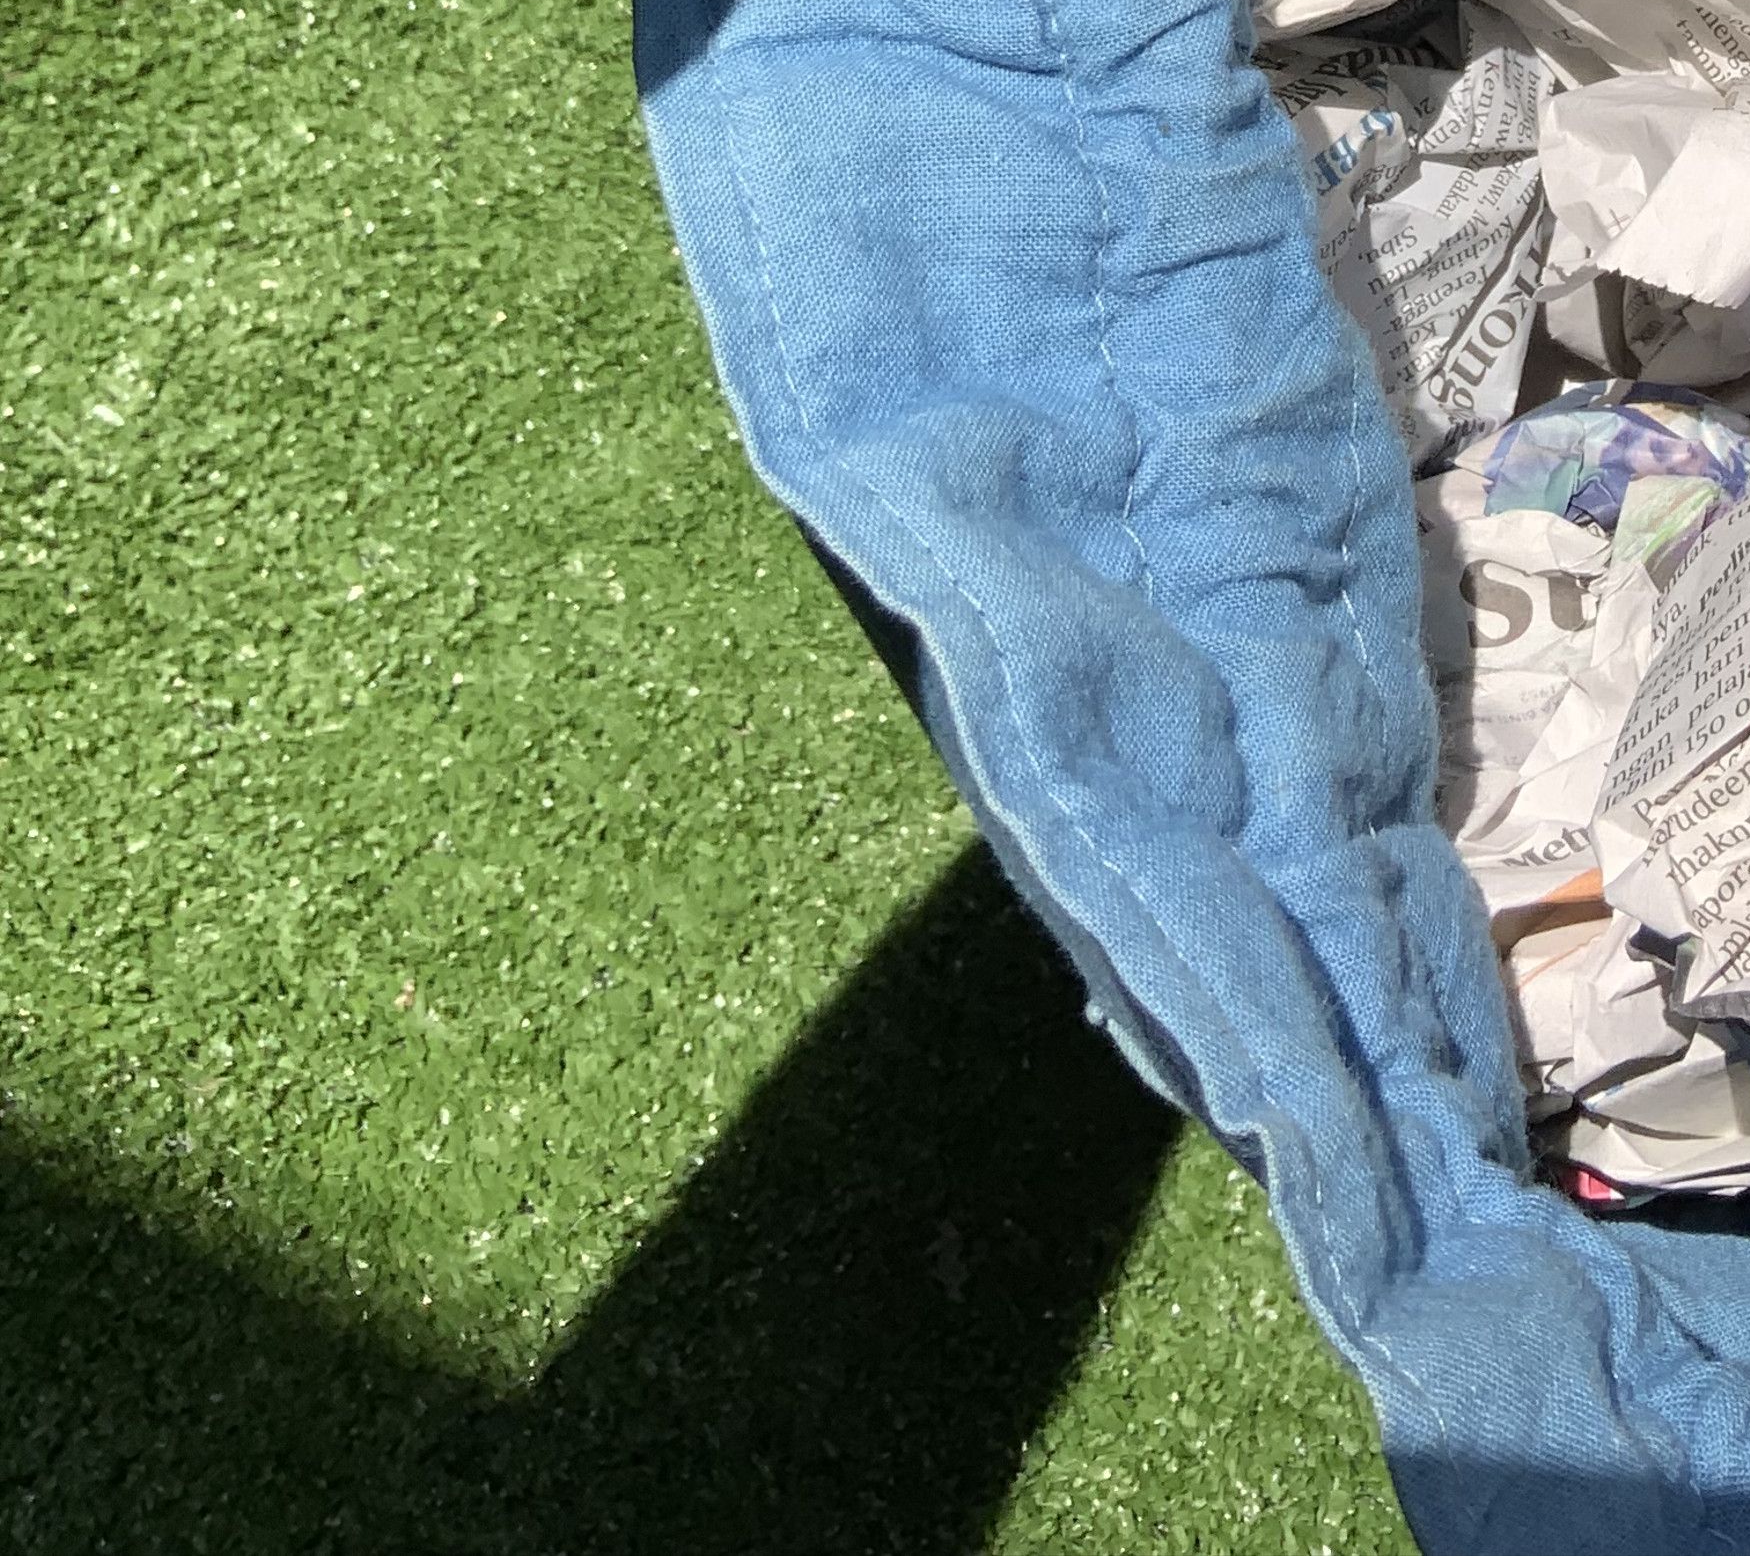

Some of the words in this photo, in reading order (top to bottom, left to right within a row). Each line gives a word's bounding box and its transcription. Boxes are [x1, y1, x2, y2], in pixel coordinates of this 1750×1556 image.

[1355, 226, 1419, 266] Sibu,
[1606, 696, 1685, 761] muka
[1685, 636, 1750, 690] hari
[1678, 711, 1730, 755] 150
